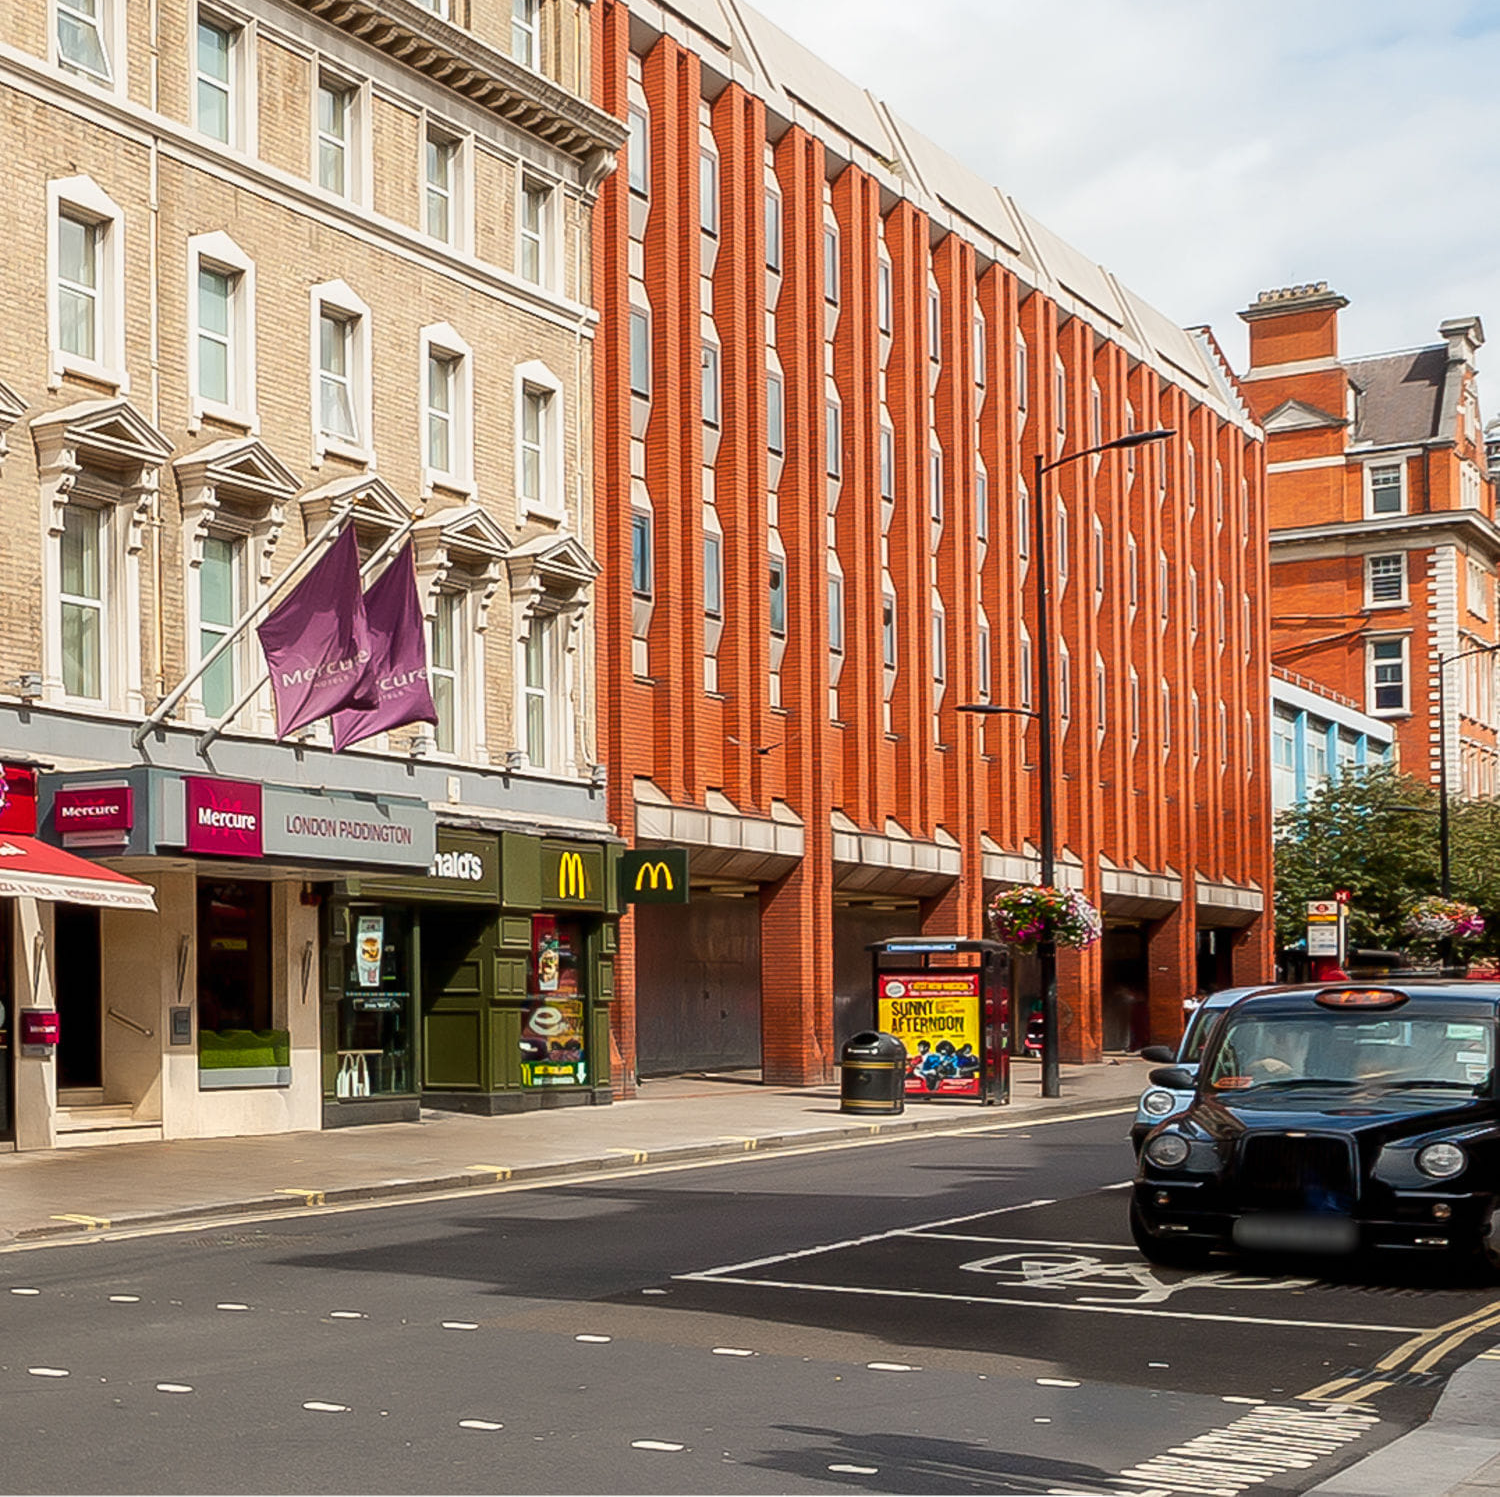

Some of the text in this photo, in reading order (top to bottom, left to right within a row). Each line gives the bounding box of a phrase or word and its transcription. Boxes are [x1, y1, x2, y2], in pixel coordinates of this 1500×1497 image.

[375, 666, 428, 692] cure
[61, 804, 120, 818] Mercure
[198, 806, 257, 831] Mercure
[285, 814, 413, 845] LONDON PADDINGTON
[428, 852, 483, 881] nald's
[891, 1000, 934, 1017] SUNNY
[891, 1016, 965, 1034] AFTERNOON
